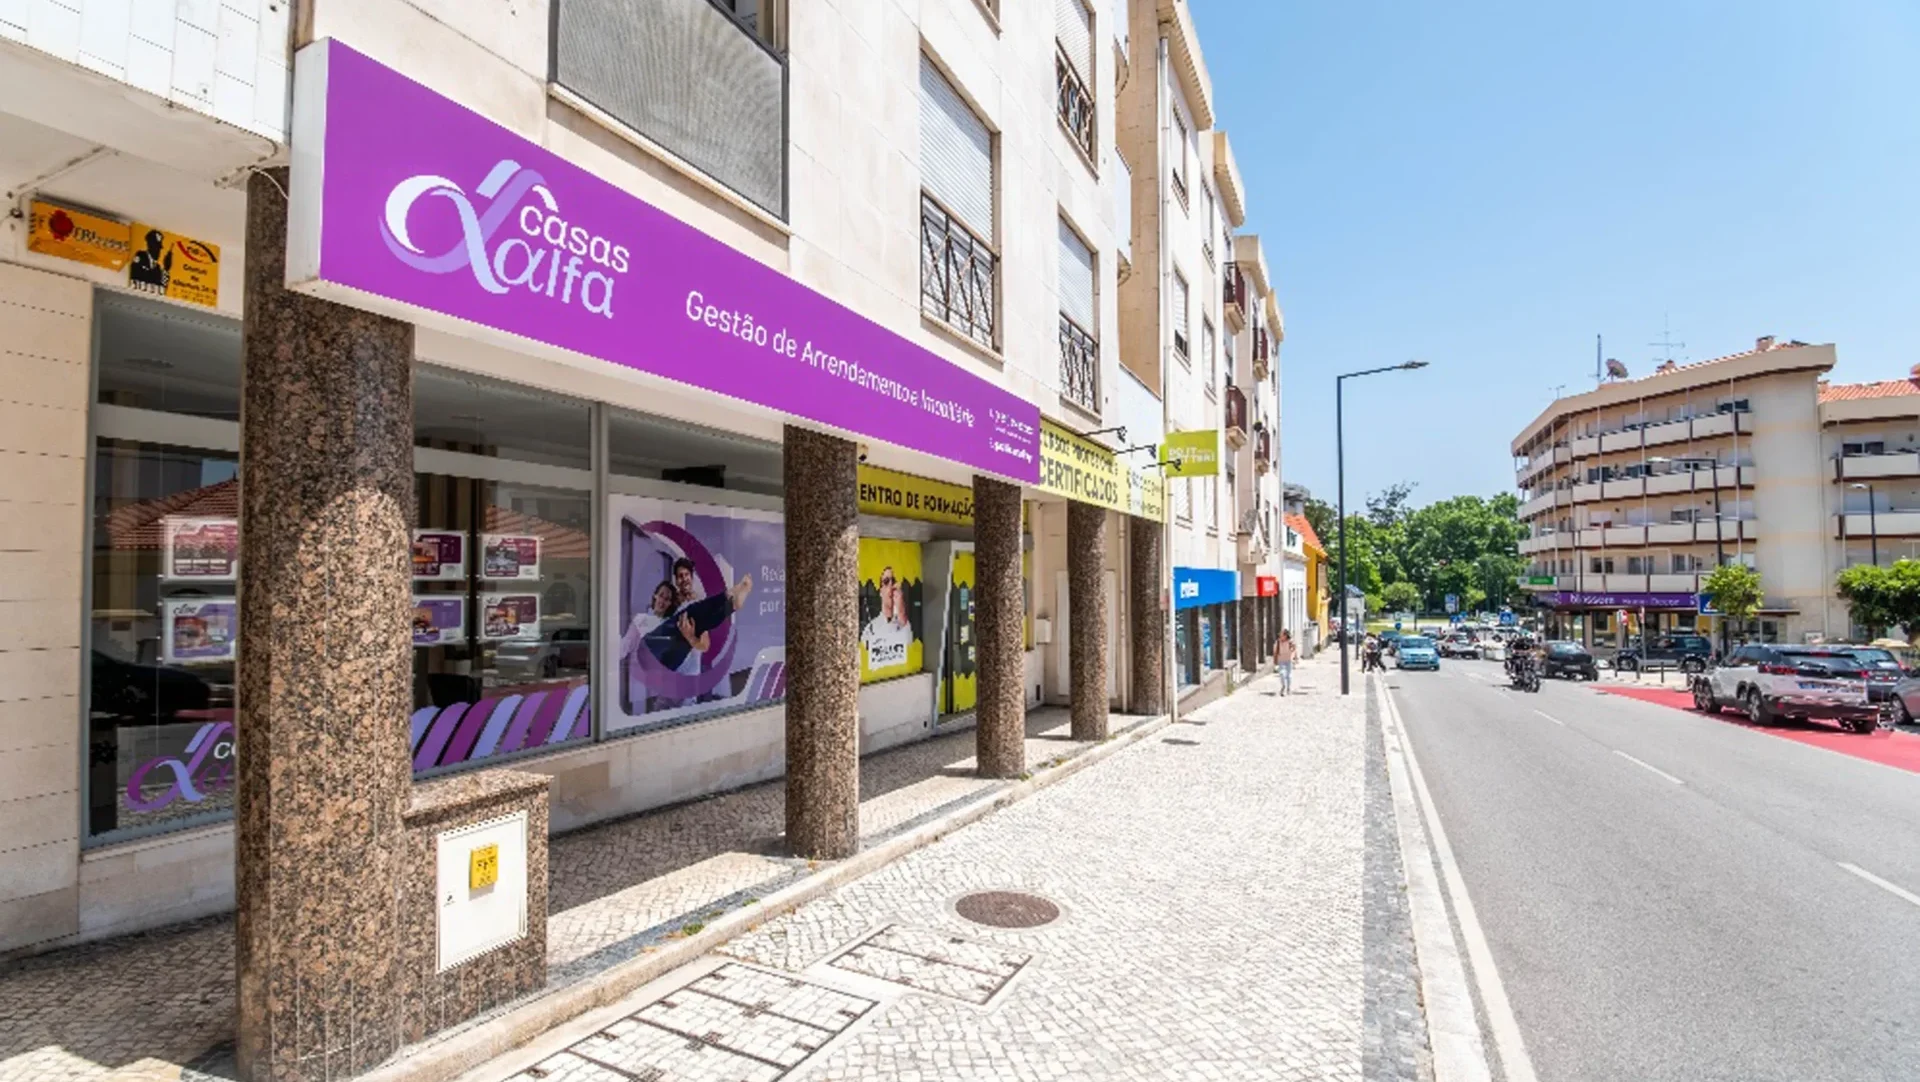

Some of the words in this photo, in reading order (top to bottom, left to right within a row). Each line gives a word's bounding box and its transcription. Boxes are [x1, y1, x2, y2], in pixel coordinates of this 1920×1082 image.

[519, 204, 631, 273] casas
[493, 238, 616, 320] alfa
[686, 290, 768, 347] Gestão
[773, 327, 798, 358] de
[906, 491, 919, 509] DE
